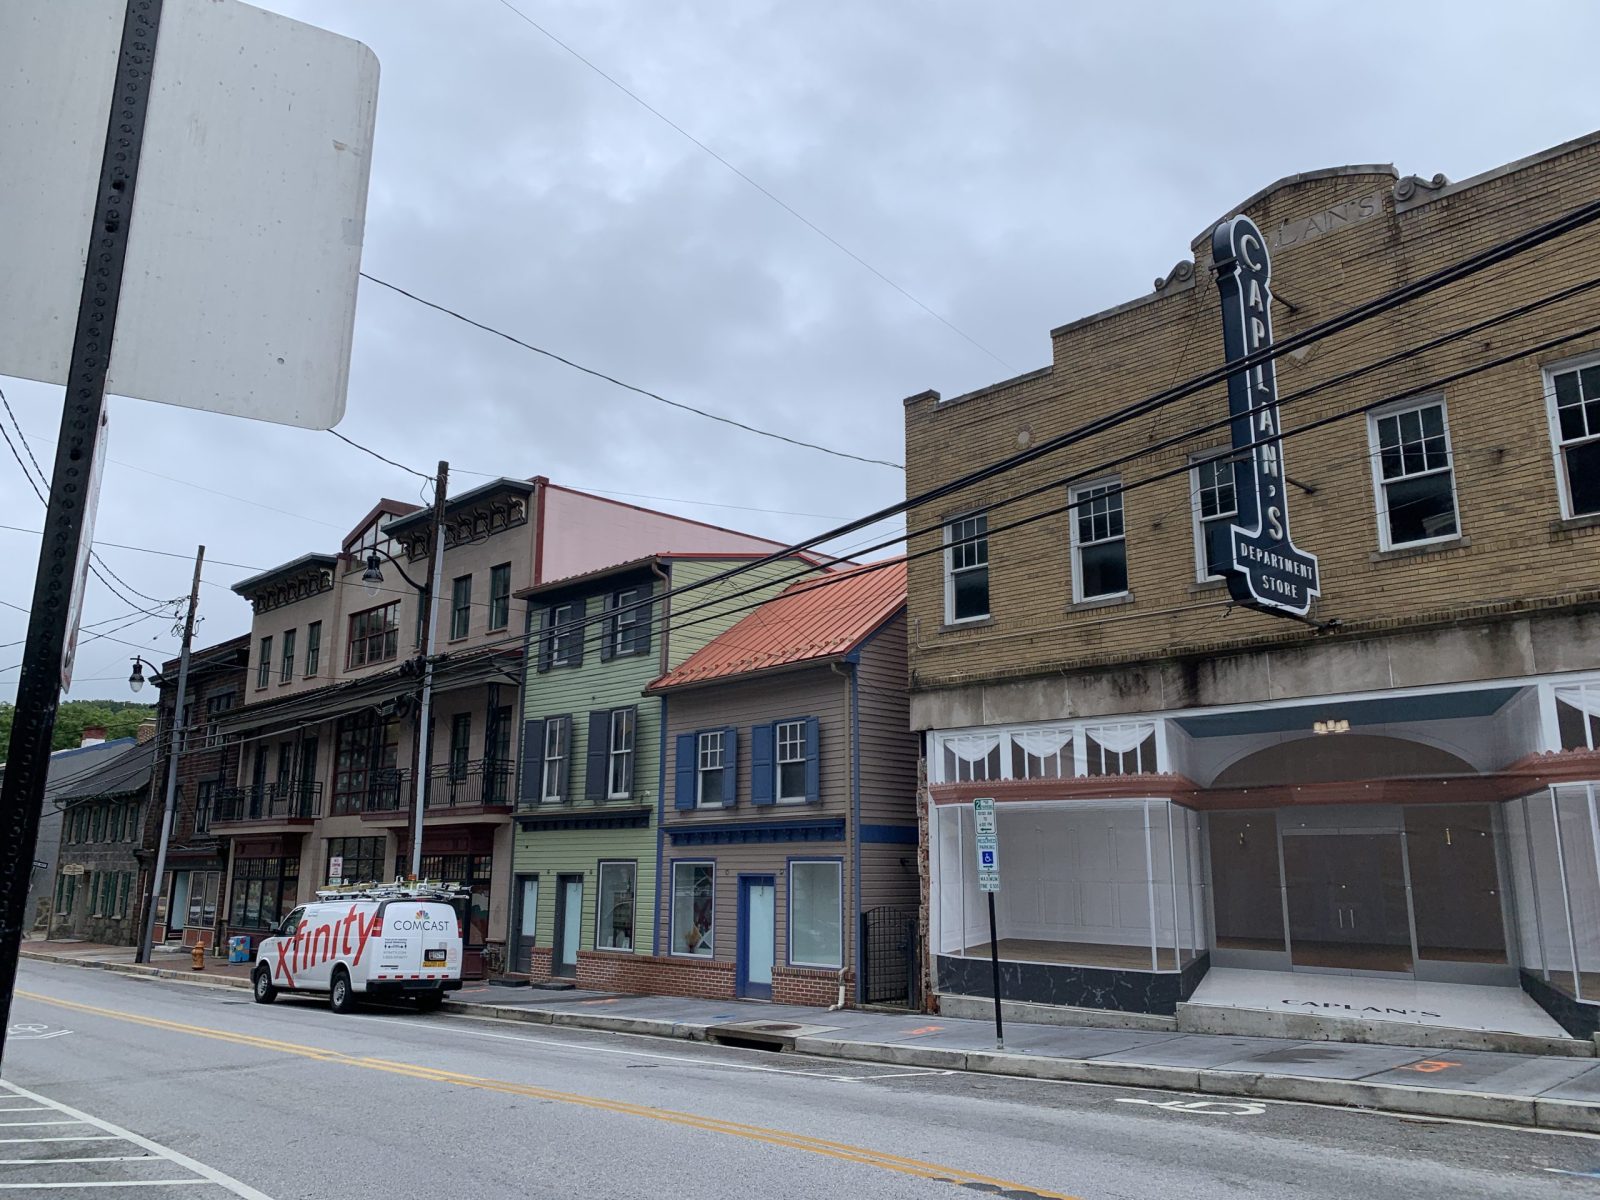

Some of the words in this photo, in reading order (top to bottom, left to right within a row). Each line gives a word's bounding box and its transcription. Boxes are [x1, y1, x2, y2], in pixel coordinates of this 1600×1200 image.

[1265, 194, 1375, 247] LAN'S
[1240, 234, 1284, 541] CAPLAN'S
[1240, 542, 1313, 580] DEPARTMENT
[1262, 575, 1298, 599] STORE
[393, 920, 449, 931] COMCAST
[275, 904, 377, 988] xfinity
[1282, 1000, 1441, 1017] CAPLAN'S
